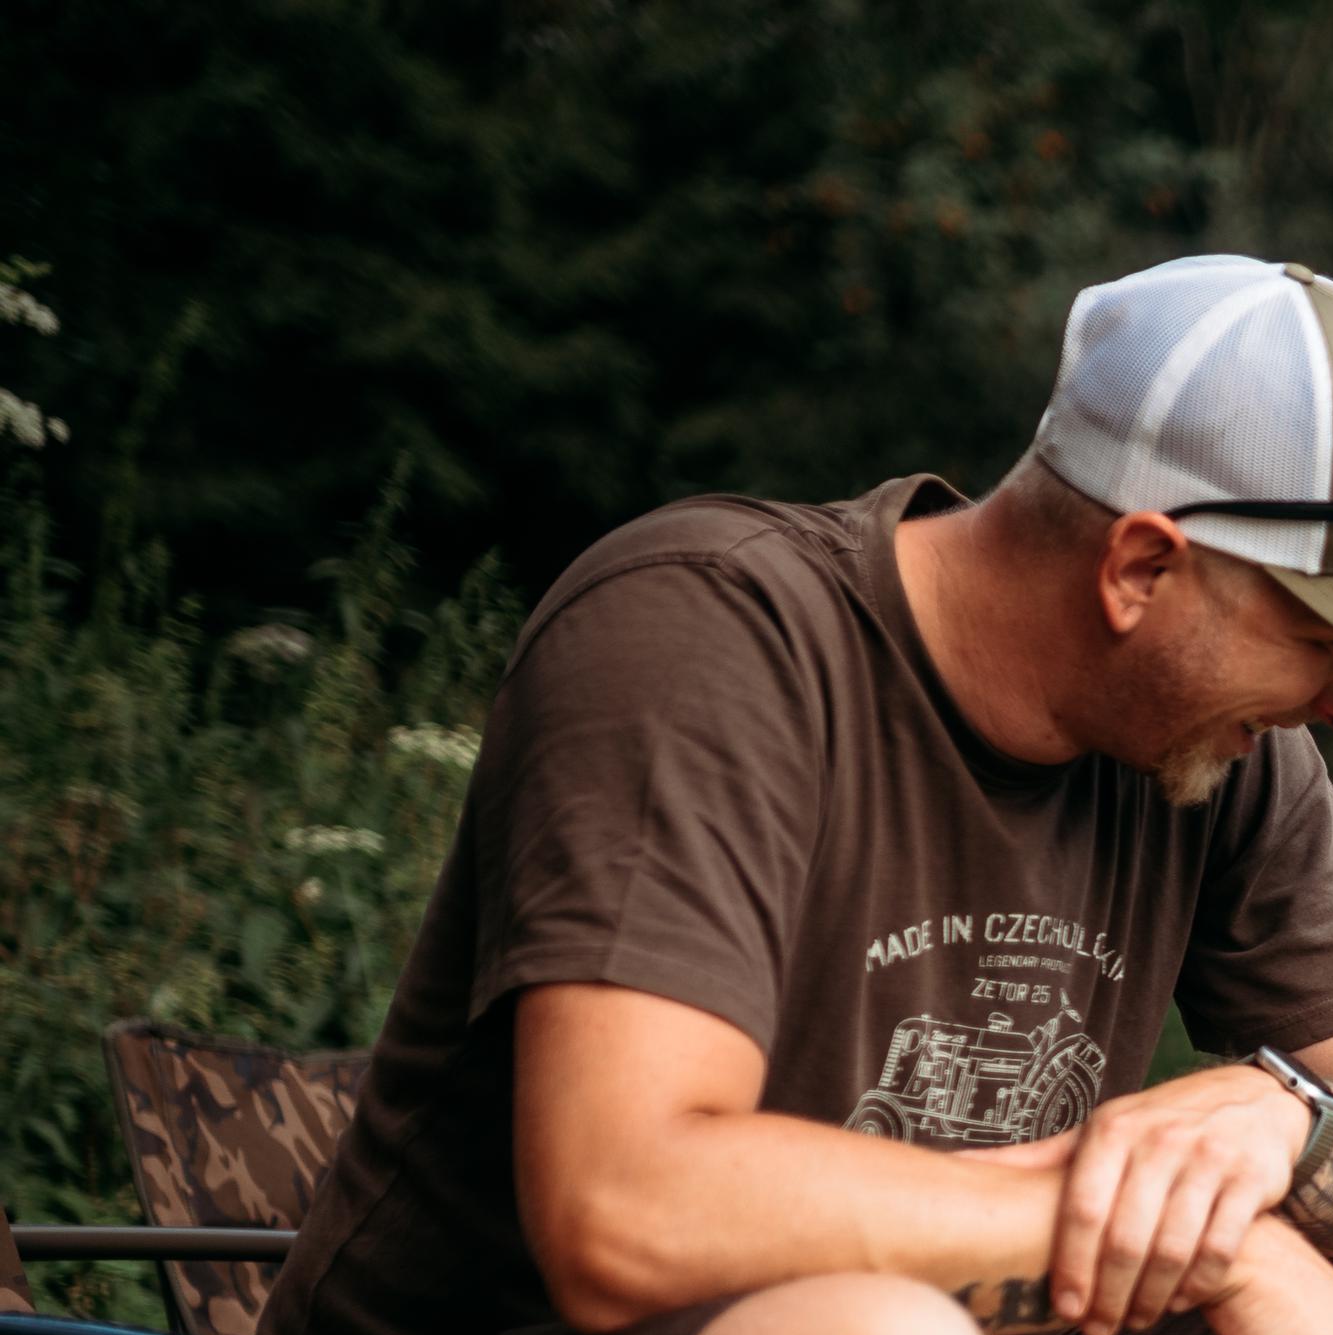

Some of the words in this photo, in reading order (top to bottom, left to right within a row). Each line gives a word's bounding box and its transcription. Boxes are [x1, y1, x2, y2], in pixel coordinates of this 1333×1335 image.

[866, 919, 934, 973] MADE
[942, 914, 973, 944] IN
[971, 977, 1030, 1001] ZETOR
[1030, 984, 1052, 1003] 25
